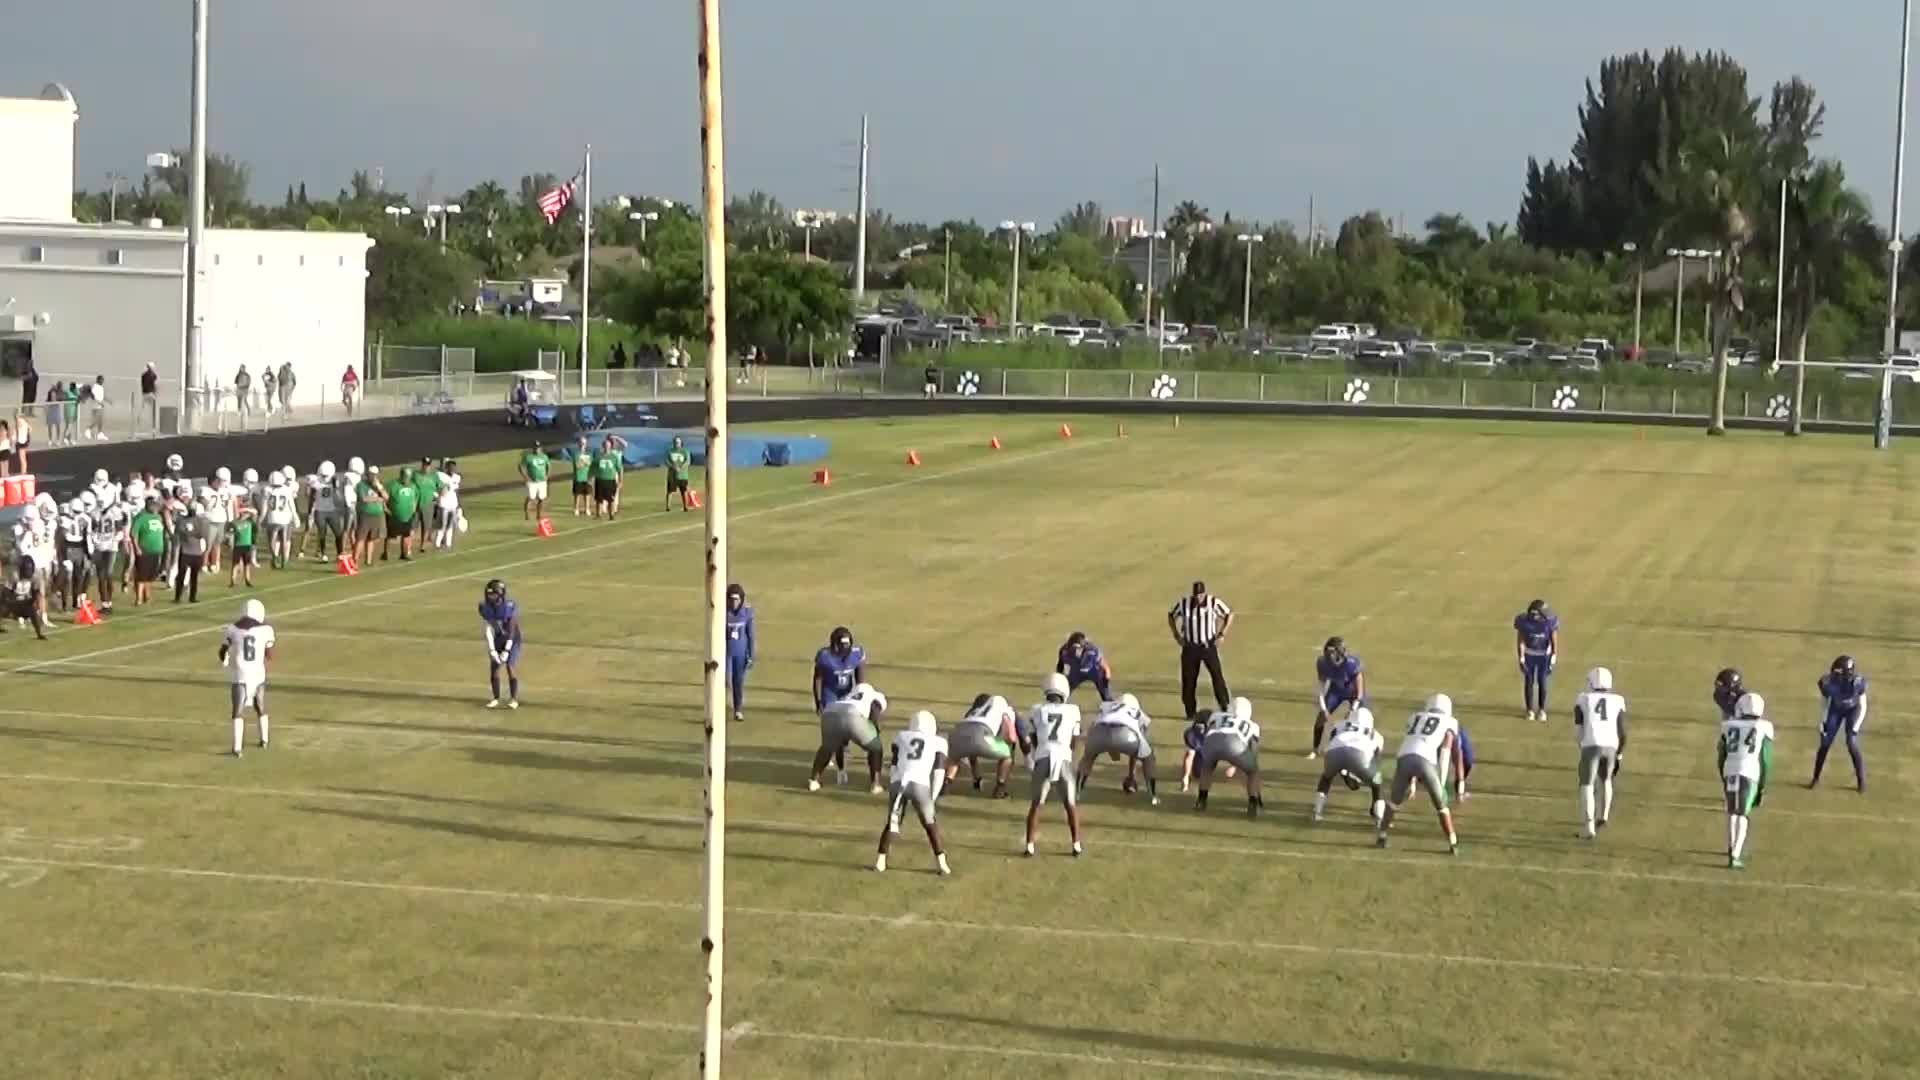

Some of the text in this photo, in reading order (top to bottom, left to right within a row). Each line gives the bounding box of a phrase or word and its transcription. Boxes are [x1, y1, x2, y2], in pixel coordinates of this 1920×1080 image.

[242, 635, 256, 662] 6
[1594, 699, 1609, 721] 4
[1047, 713, 1064, 741] 7
[1408, 715, 1440, 736] 18
[907, 738, 925, 760] 3
[1726, 727, 1758, 754] 24
